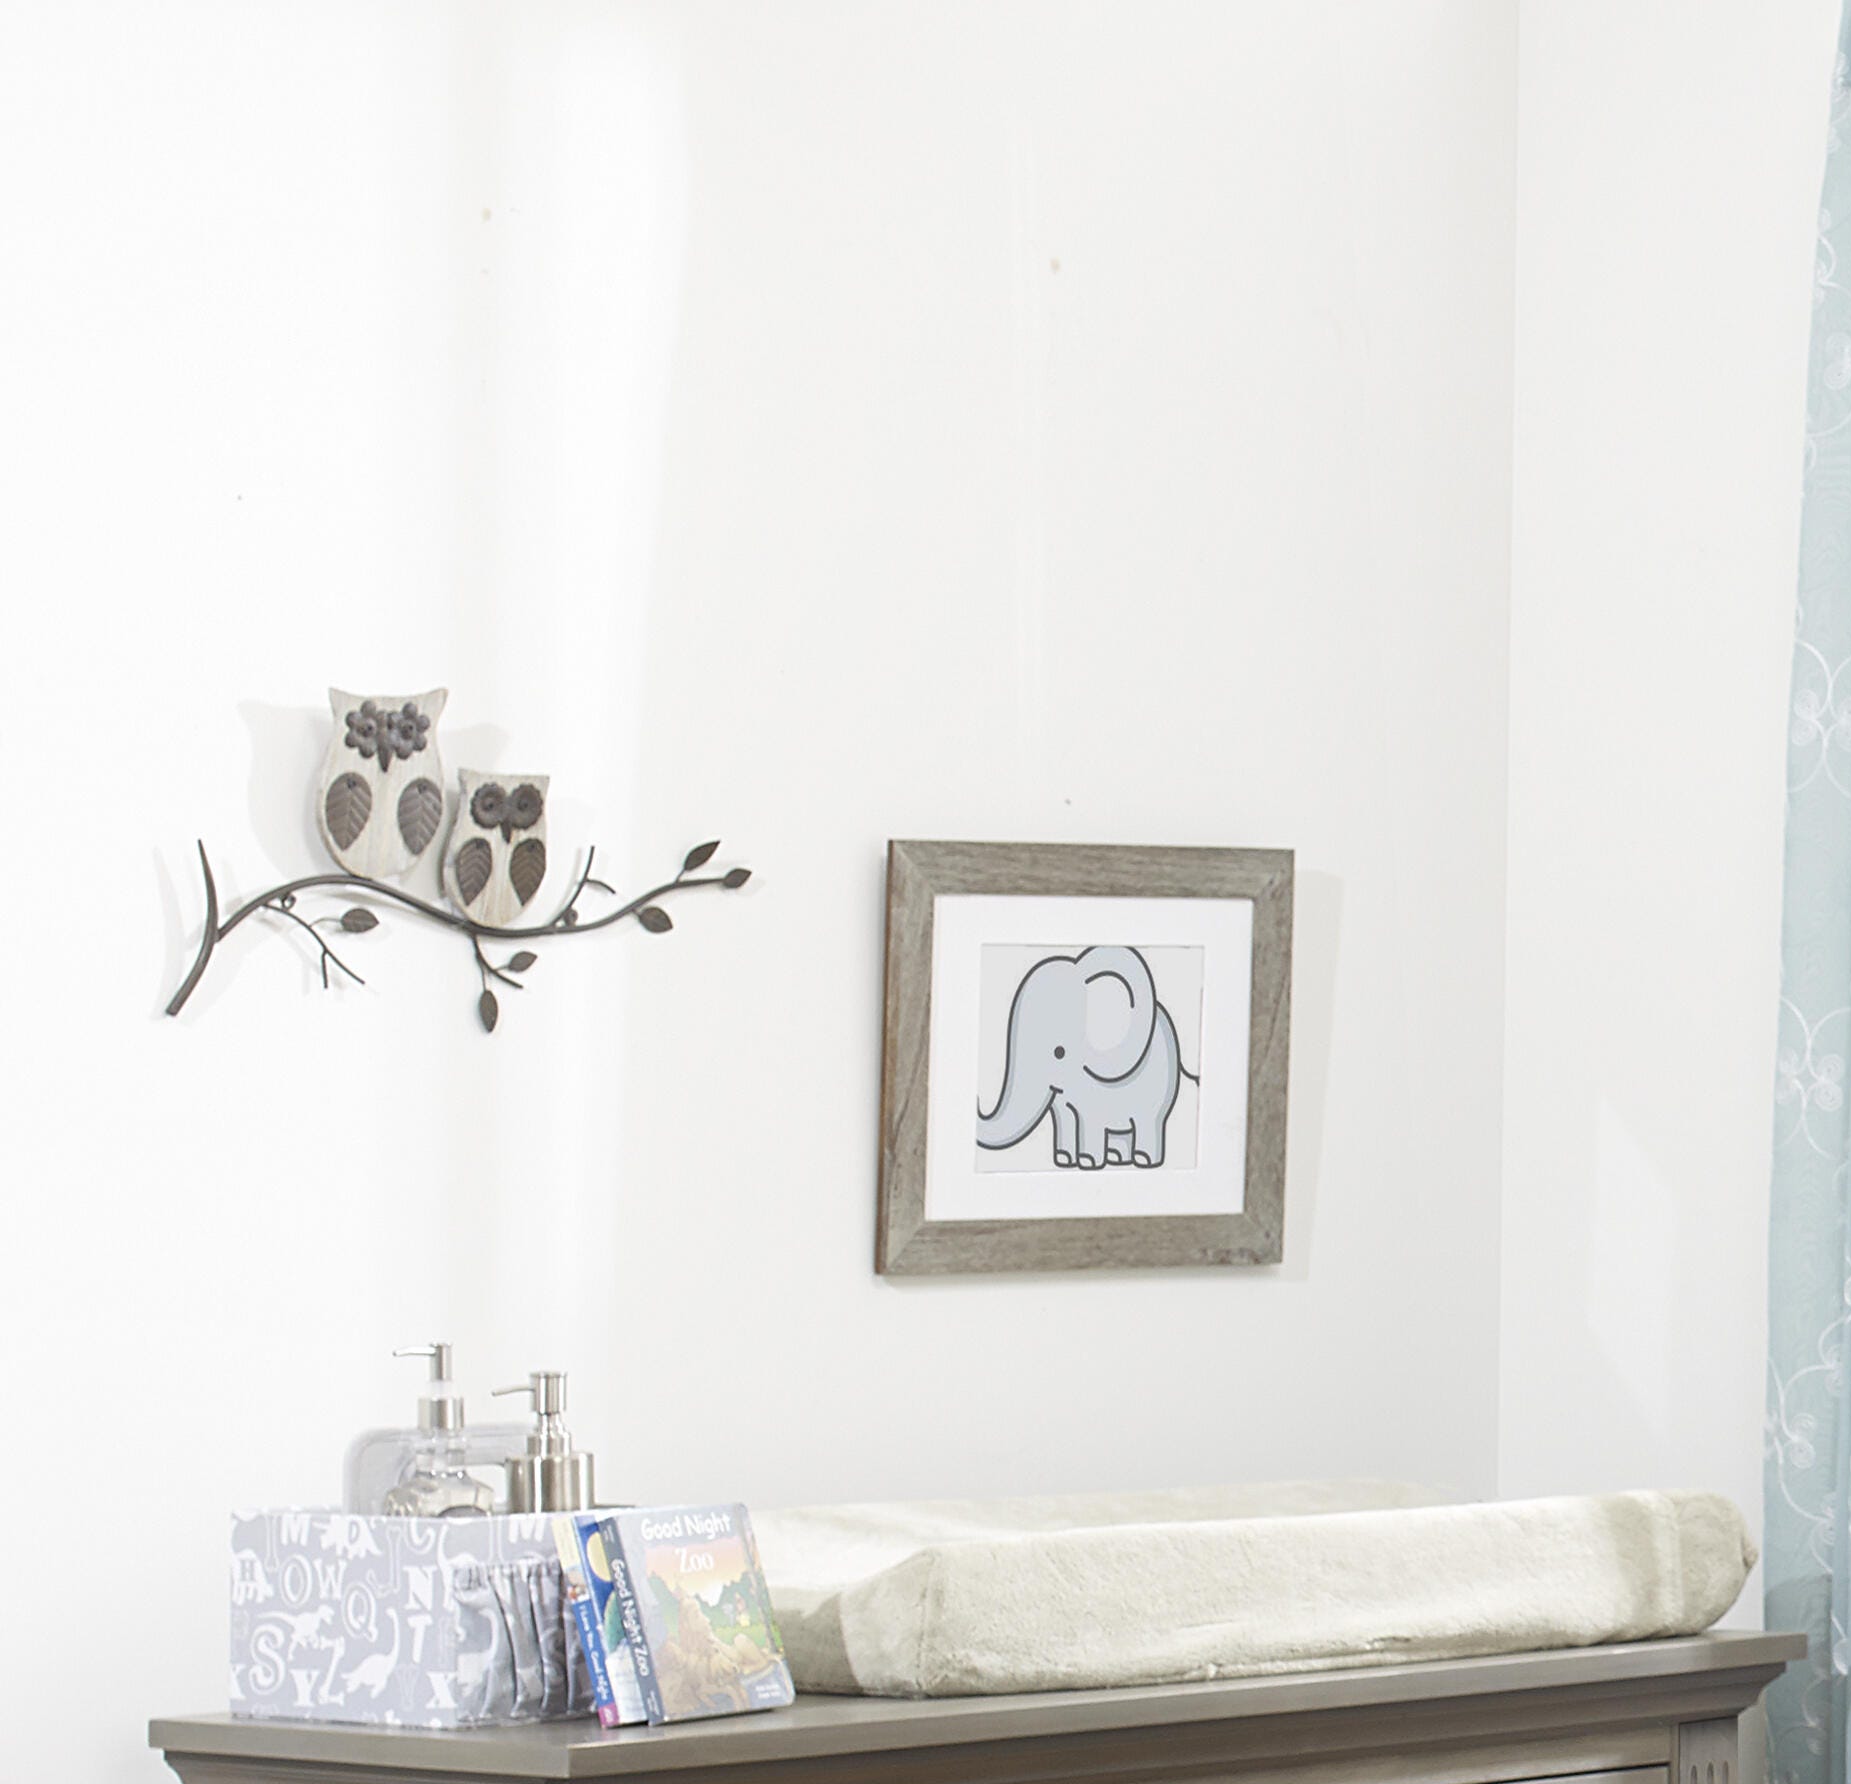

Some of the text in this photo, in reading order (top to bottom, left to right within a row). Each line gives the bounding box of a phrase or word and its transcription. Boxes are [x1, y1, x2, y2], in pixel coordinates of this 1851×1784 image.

[641, 1517, 683, 1540] Good
[684, 1512, 731, 1540] Night
[673, 1550, 714, 1573] Zoo
[610, 1558, 650, 1677] Good Night Zoo
